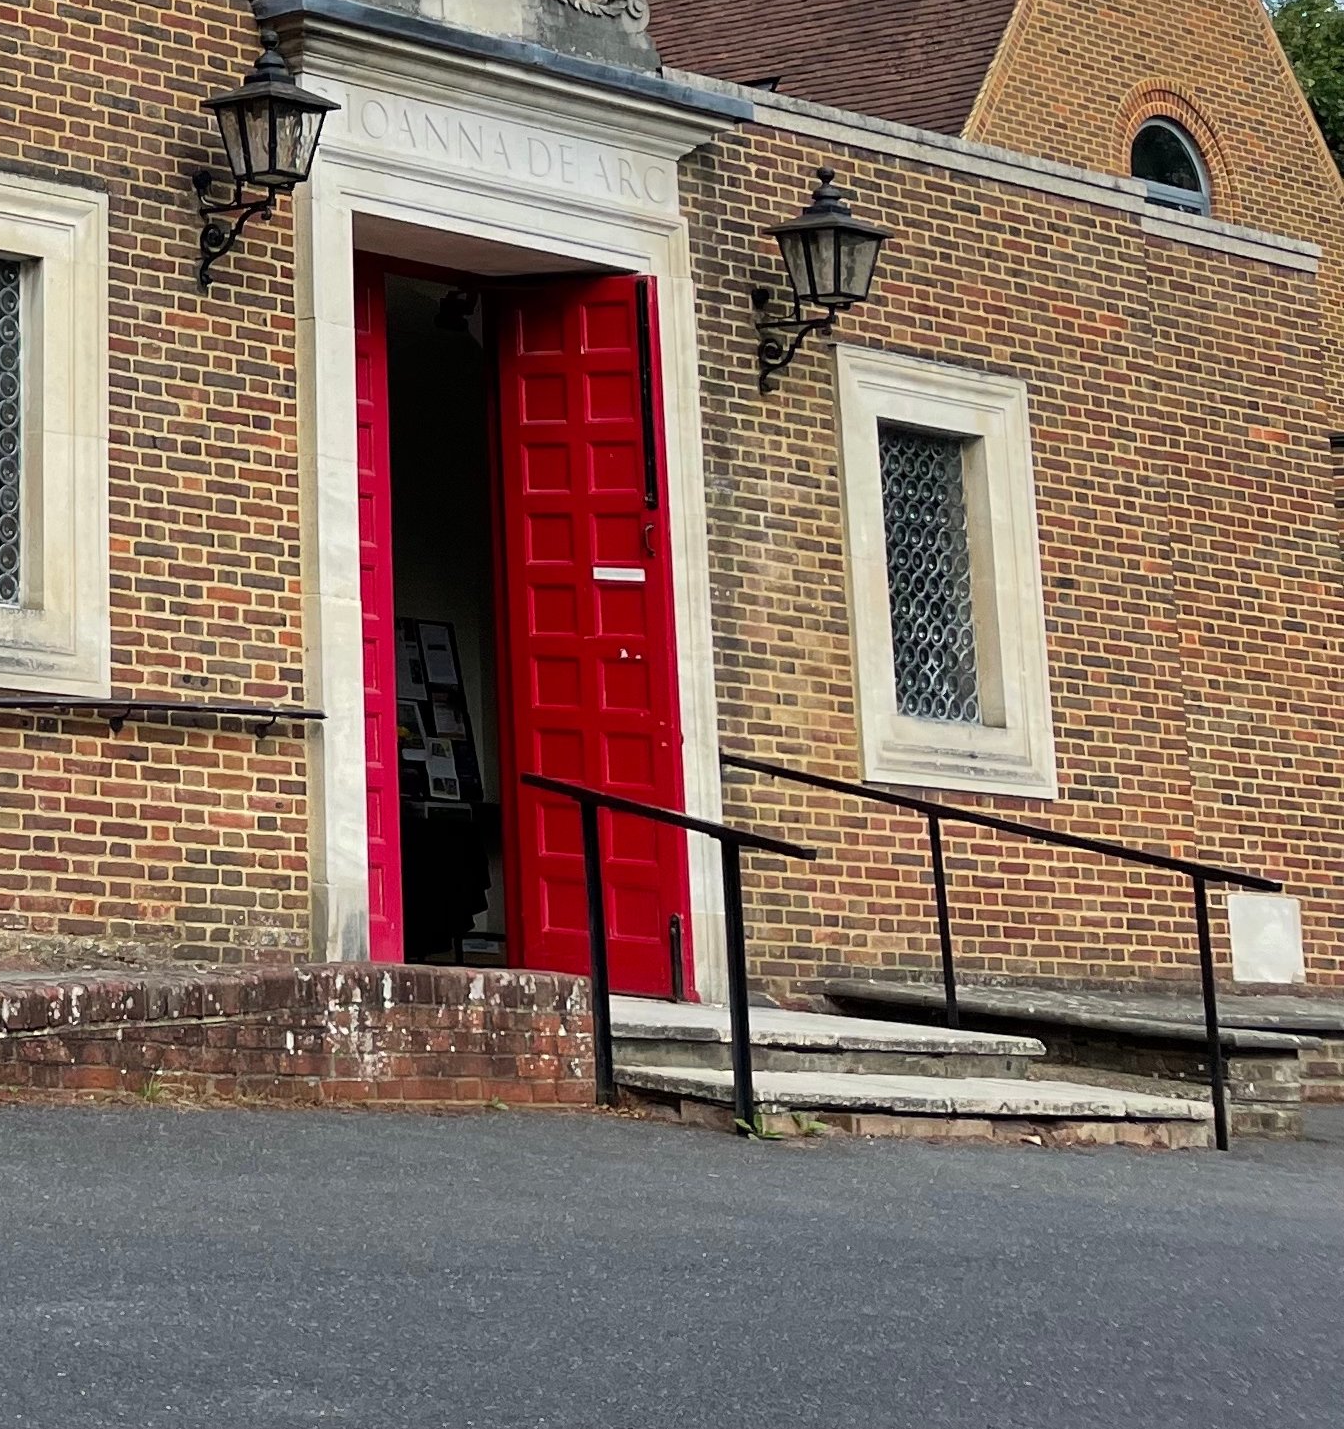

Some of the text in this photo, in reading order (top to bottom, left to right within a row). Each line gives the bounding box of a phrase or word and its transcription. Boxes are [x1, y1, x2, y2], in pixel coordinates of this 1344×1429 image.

[344, 92, 667, 204] IOANNA DE ARC
